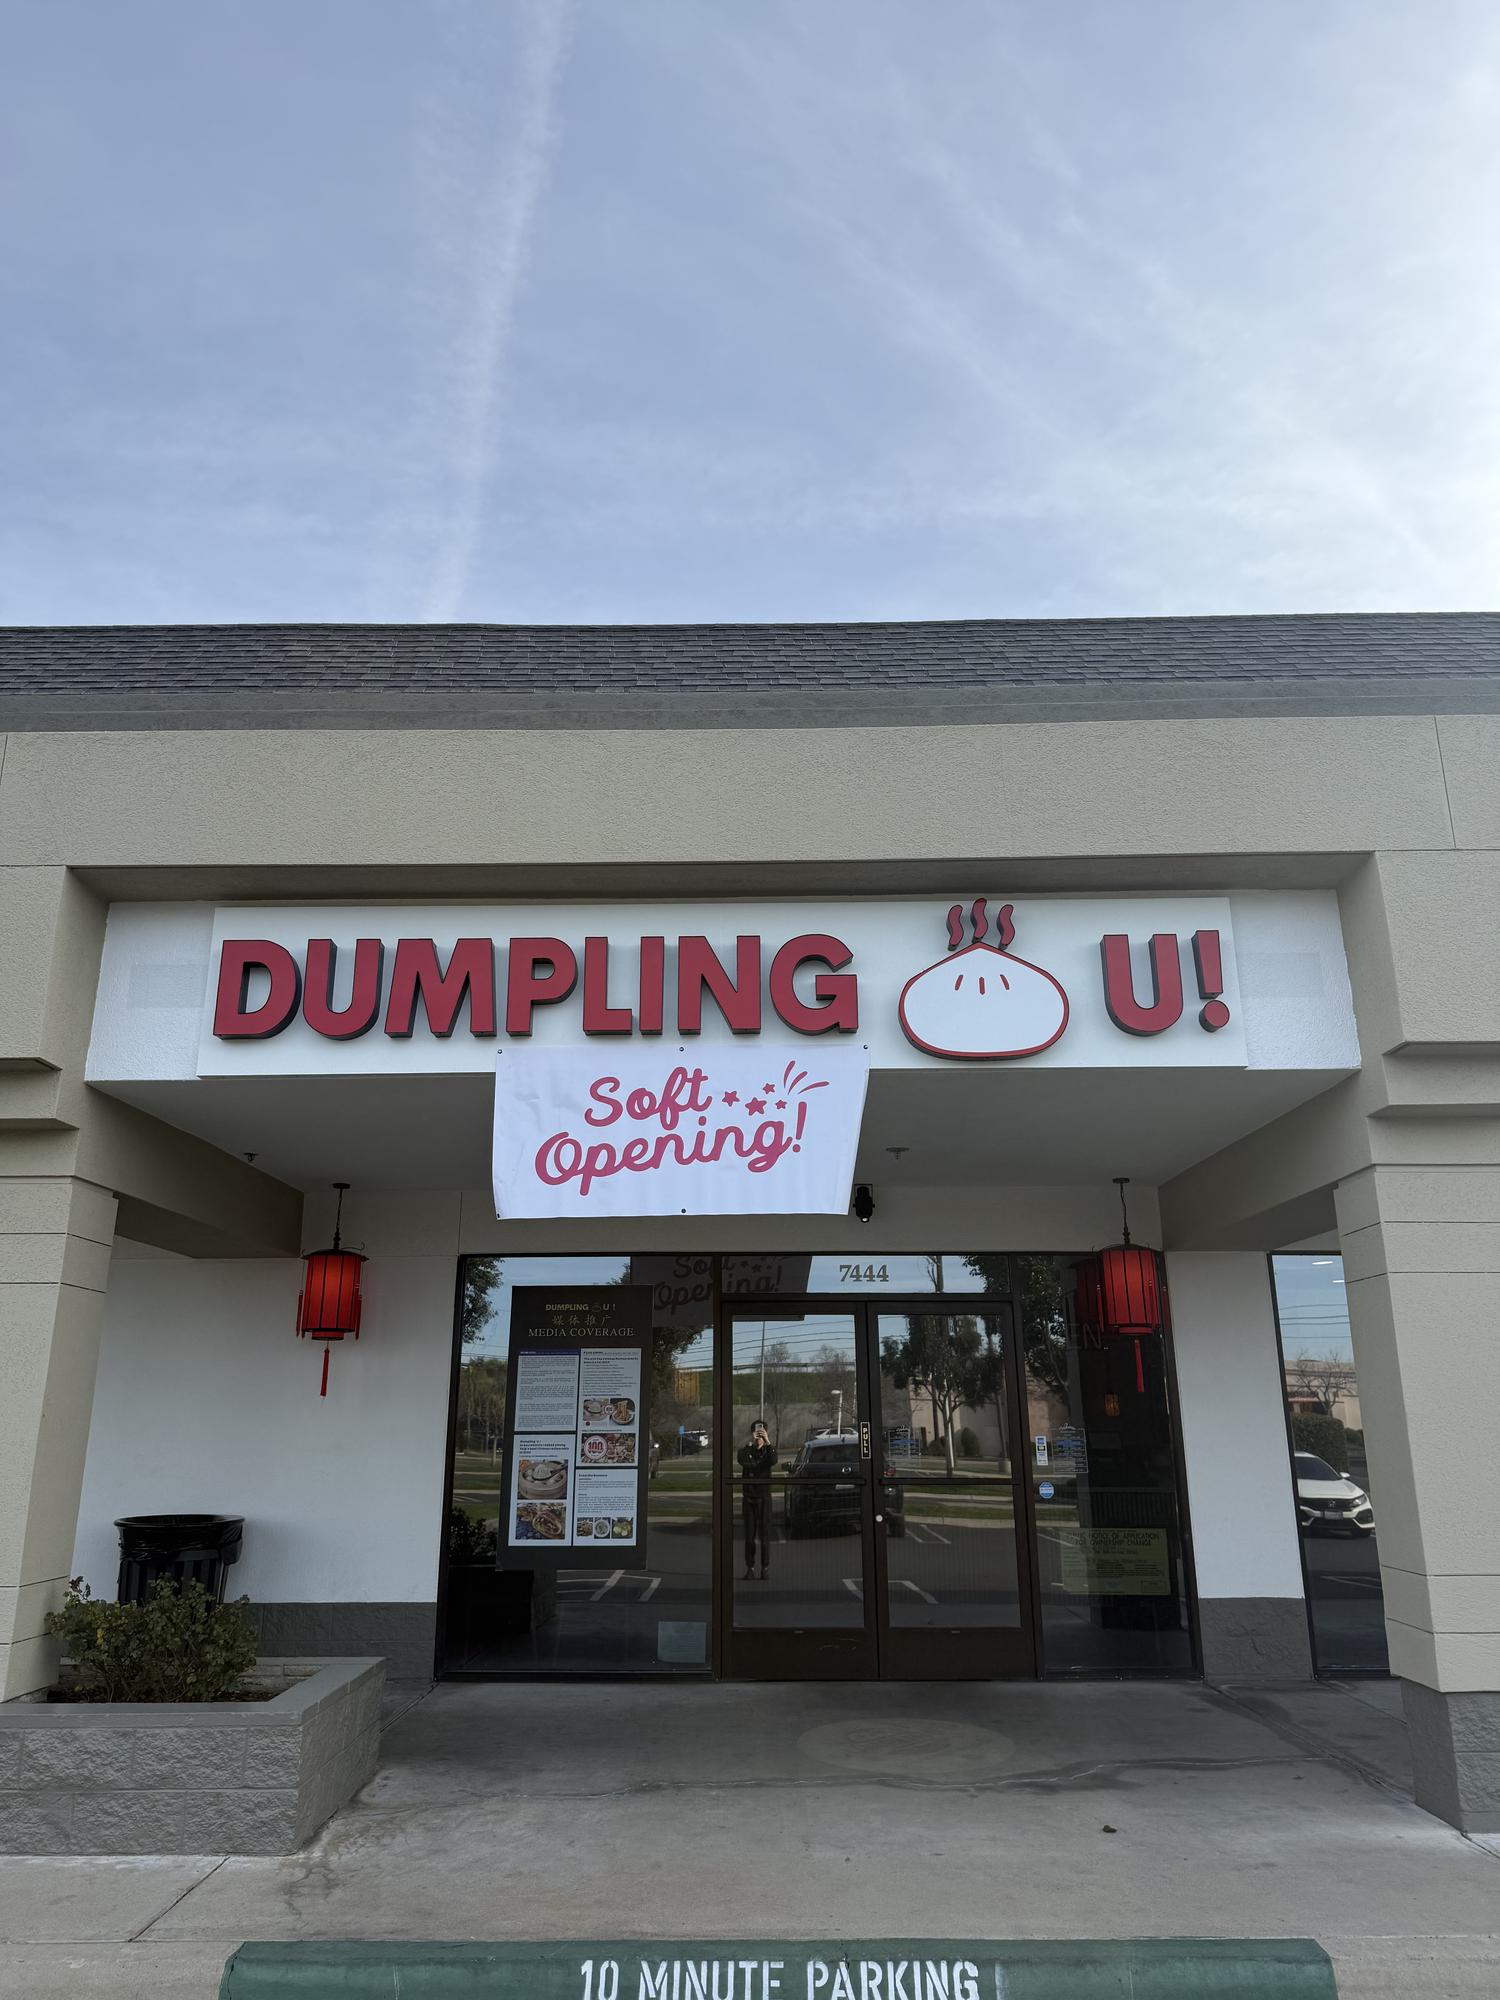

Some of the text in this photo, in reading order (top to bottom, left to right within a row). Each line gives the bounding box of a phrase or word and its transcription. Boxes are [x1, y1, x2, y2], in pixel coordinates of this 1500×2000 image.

[213, 929, 1230, 1041] DUMPLING U!
[584, 1066, 713, 1131] Soft
[535, 1101, 807, 1196] Opening!
[839, 1264, 890, 1282] 7444
[545, 1303, 589, 1311] DUMPLING
[528, 1327, 635, 1337] MEDIA COVERAGE
[580, 1960, 980, 2000] 10 MINUTE PARKING
